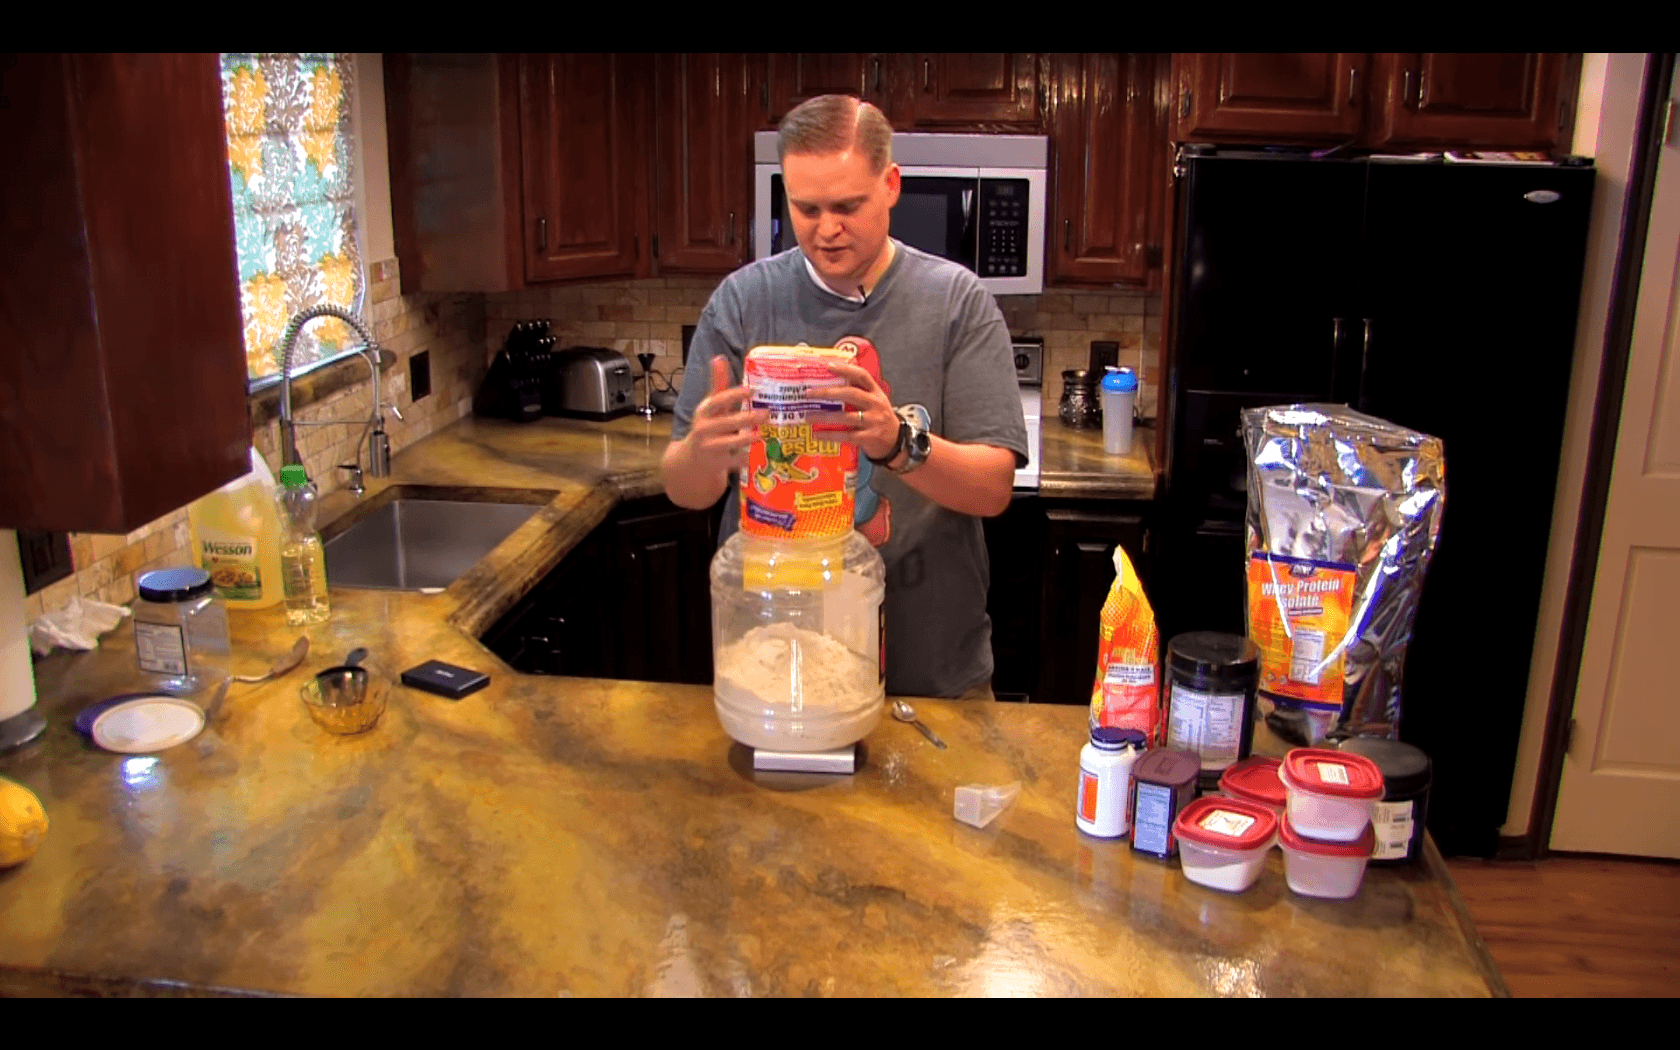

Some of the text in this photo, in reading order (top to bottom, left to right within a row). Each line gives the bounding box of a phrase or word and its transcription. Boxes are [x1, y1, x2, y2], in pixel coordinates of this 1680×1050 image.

[782, 440, 839, 456] masa
[202, 540, 252, 555] Wesson
[1297, 578, 1340, 593] Protein
